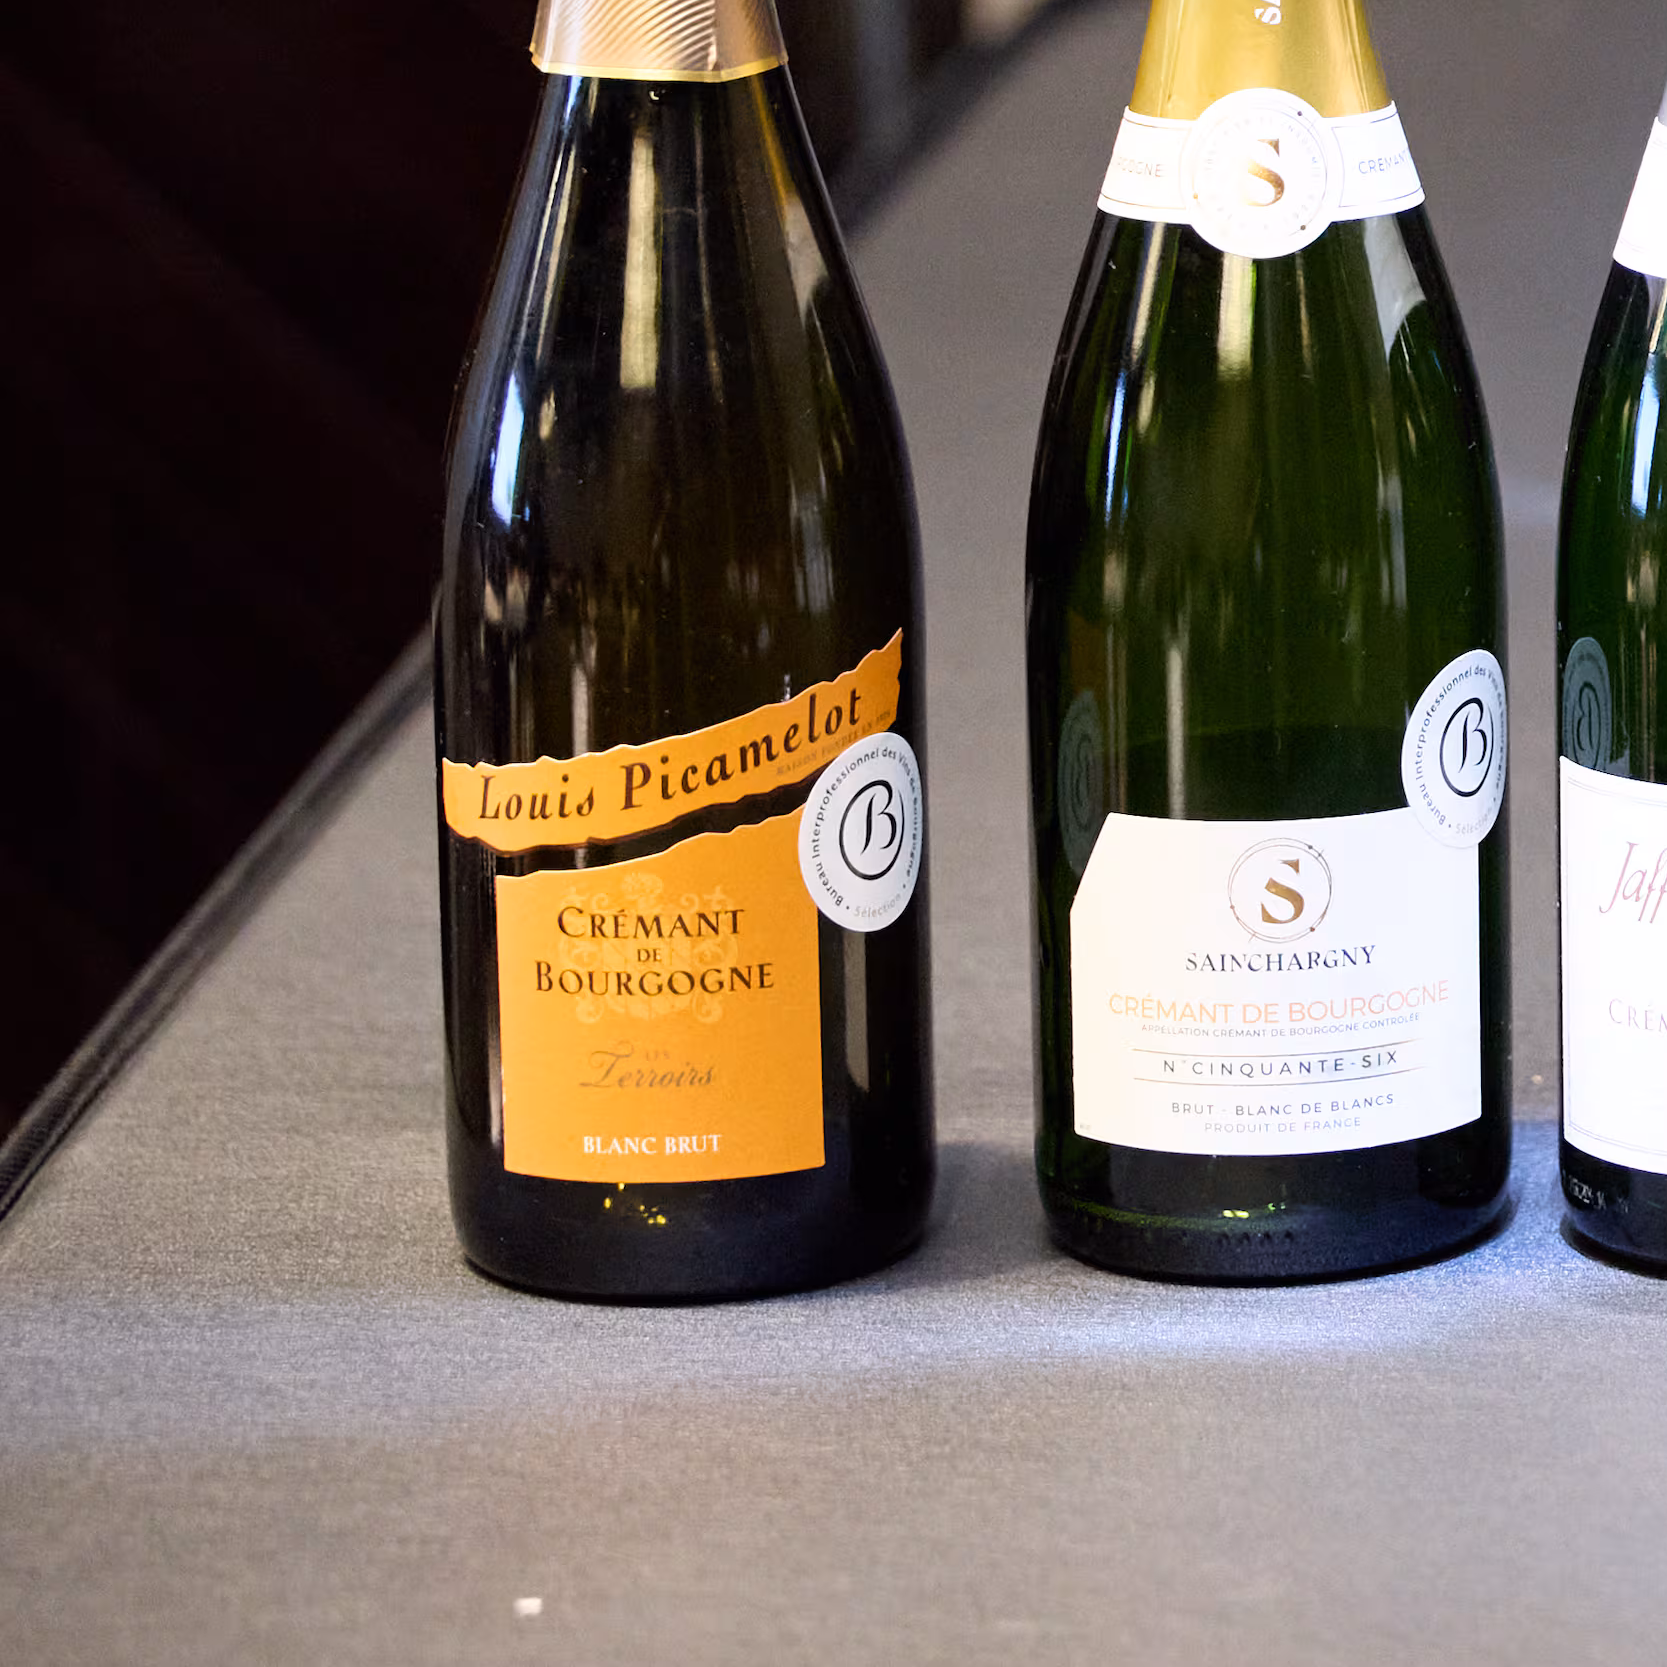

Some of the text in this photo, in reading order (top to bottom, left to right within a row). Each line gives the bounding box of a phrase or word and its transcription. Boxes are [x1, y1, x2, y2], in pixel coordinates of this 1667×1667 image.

[478, 686, 863, 820] Louis Picamelot
[880, 745, 898, 761] des
[1415, 664, 1487, 825] Bureau Interprofessionnel des
[811, 746, 881, 860] Interprofessionnel
[815, 858, 845, 908] Bureau
[557, 905, 744, 939] CRÉMANT
[636, 947, 662, 963] DE
[1184, 944, 1376, 973] SAINCHARGNY
[535, 960, 774, 996] BOURGOGNE
[1109, 979, 1450, 1024] CRÉMANT DE BOURGOGNE
[1270, 1028, 1287, 1038] DE
[1290, 1022, 1360, 1037] BOURGOGNE
[577, 1039, 716, 1090] Terroirs
[1172, 1093, 1395, 1117] BRUT BLANC DE BLANCS
[1204, 1116, 1361, 1134] PRODUIT DE FRANCE
[583, 1133, 721, 1154] BLANC BRUT
